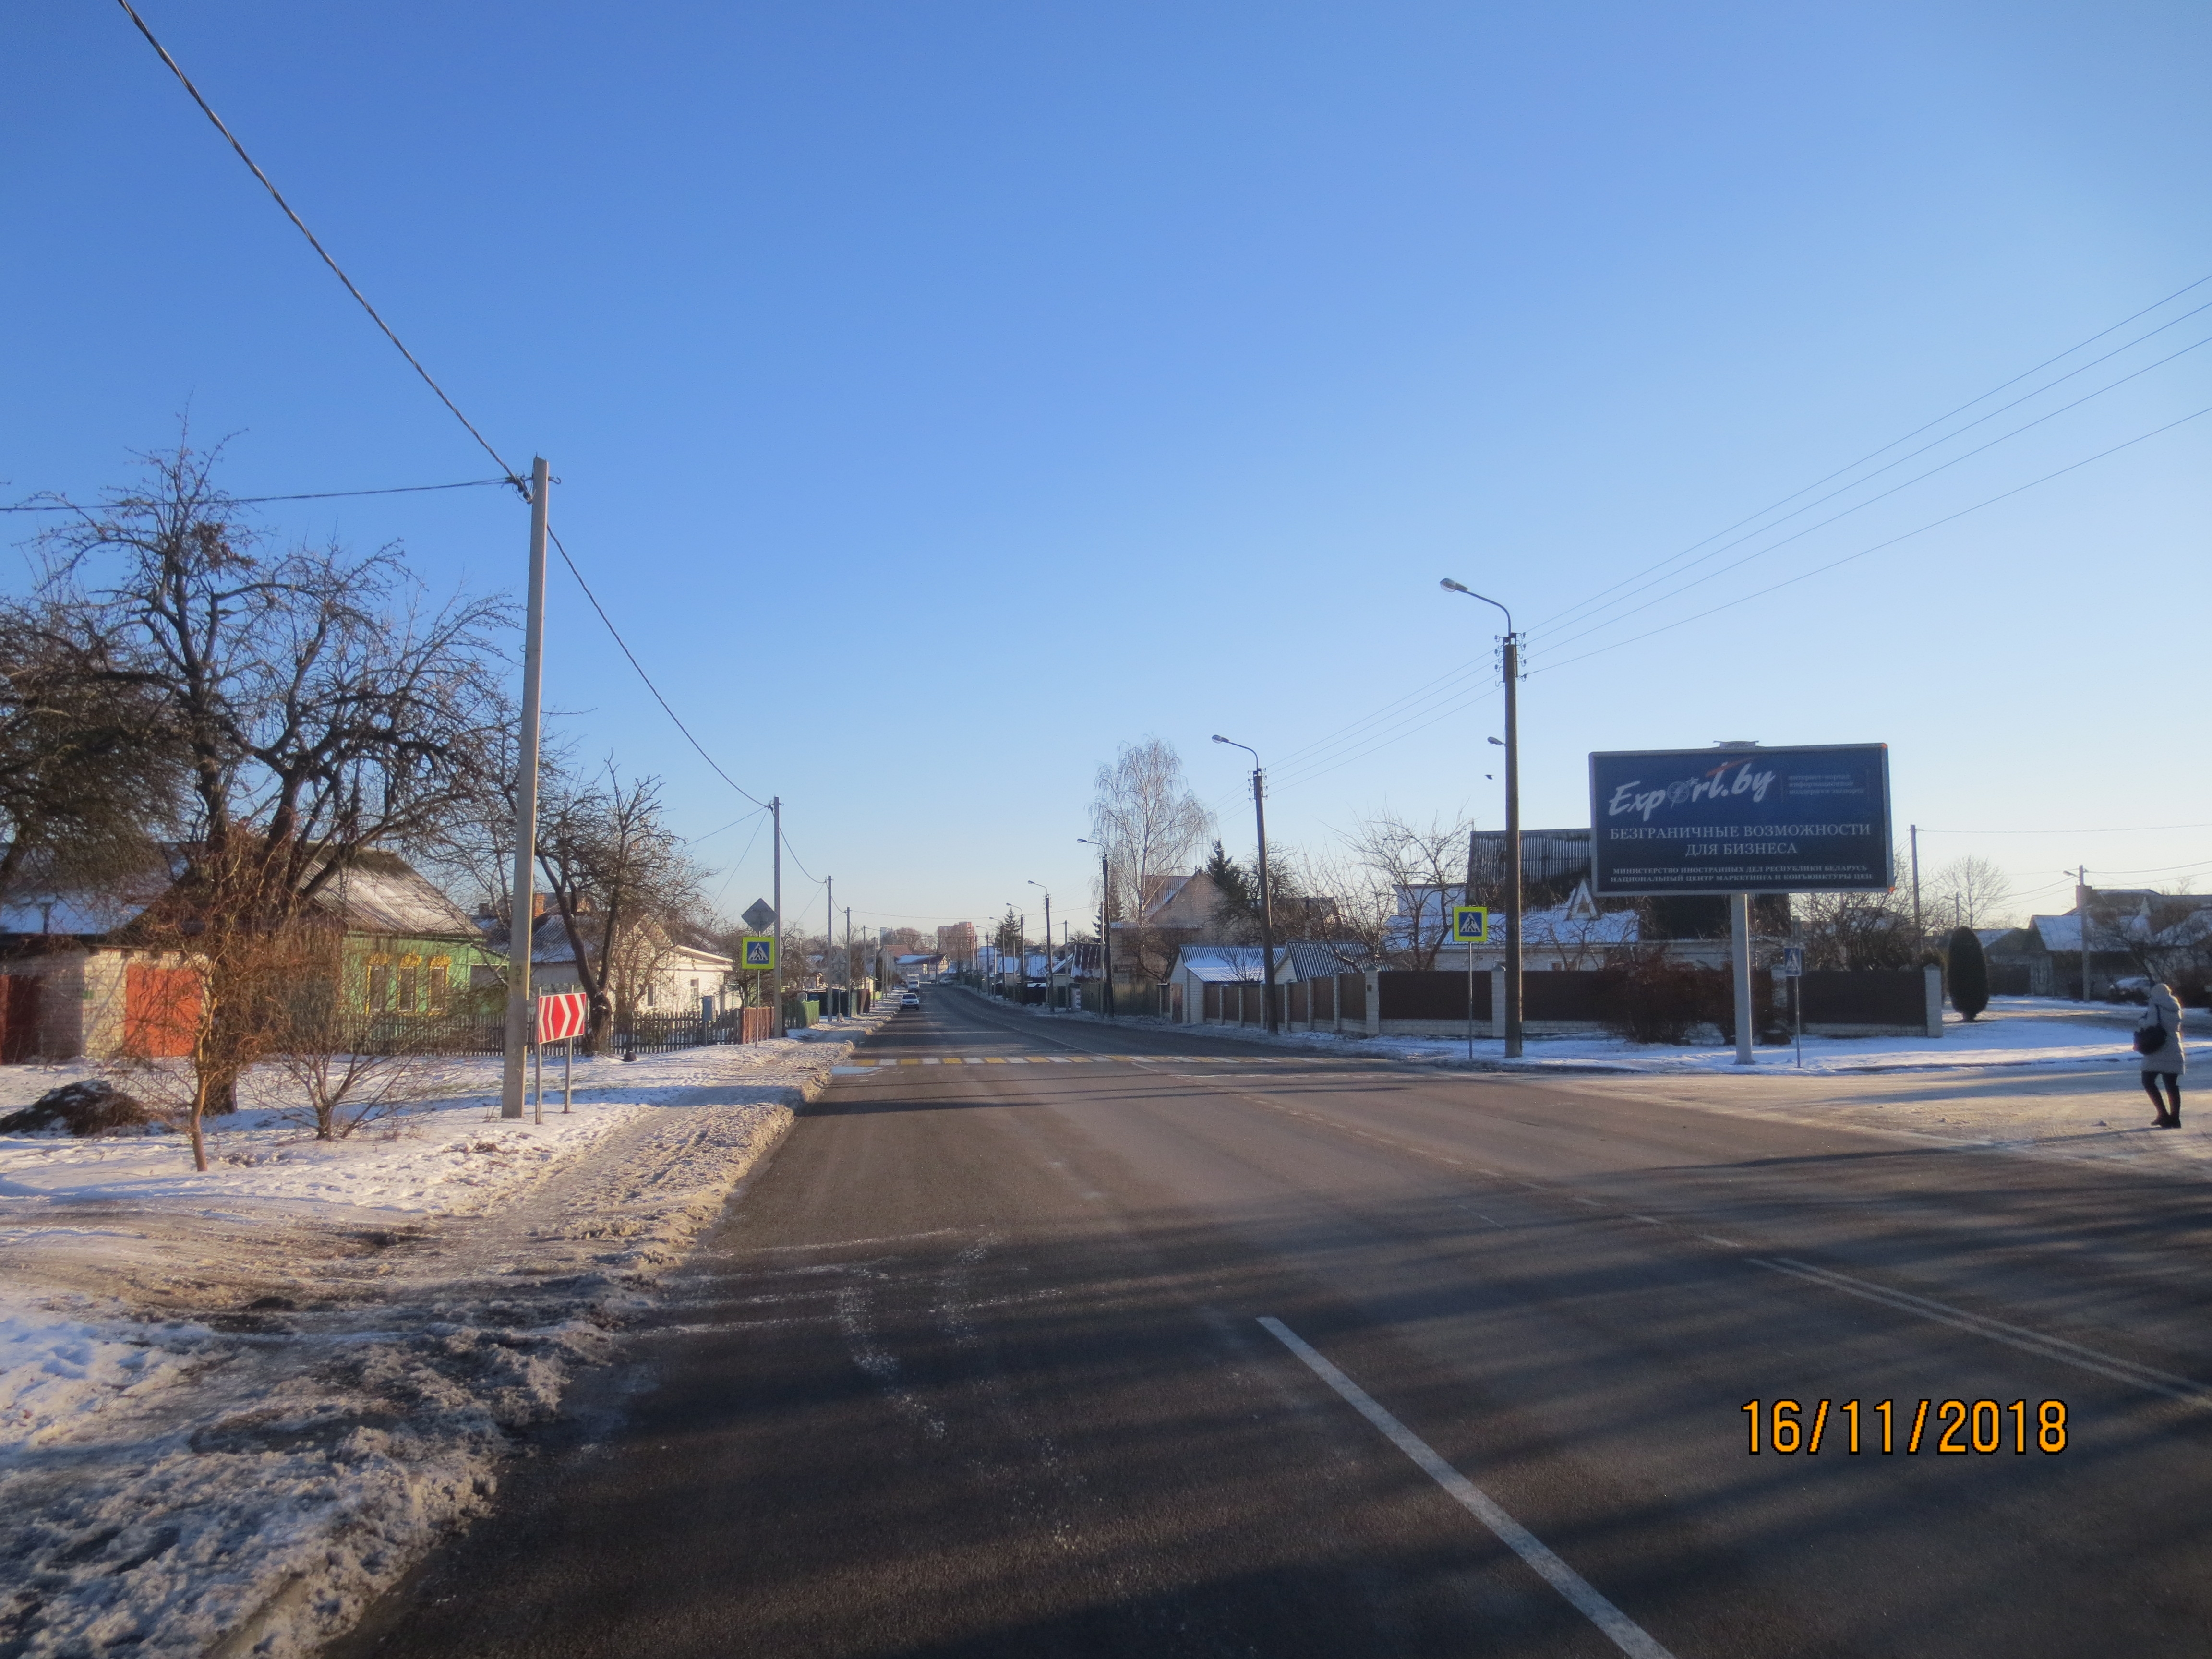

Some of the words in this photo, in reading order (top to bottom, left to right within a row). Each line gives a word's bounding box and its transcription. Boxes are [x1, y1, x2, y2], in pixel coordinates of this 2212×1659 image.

[1609, 760, 1776, 821] Export.by
[1610, 826, 1740, 840] БЕЗГРАНИЧНЫЕ
[1743, 823, 1871, 837] ВОЗМОЖНОСТИ
[1685, 844, 1718, 857] ДЛЯ
[1723, 843, 1798, 855] БИЗНЕСА
